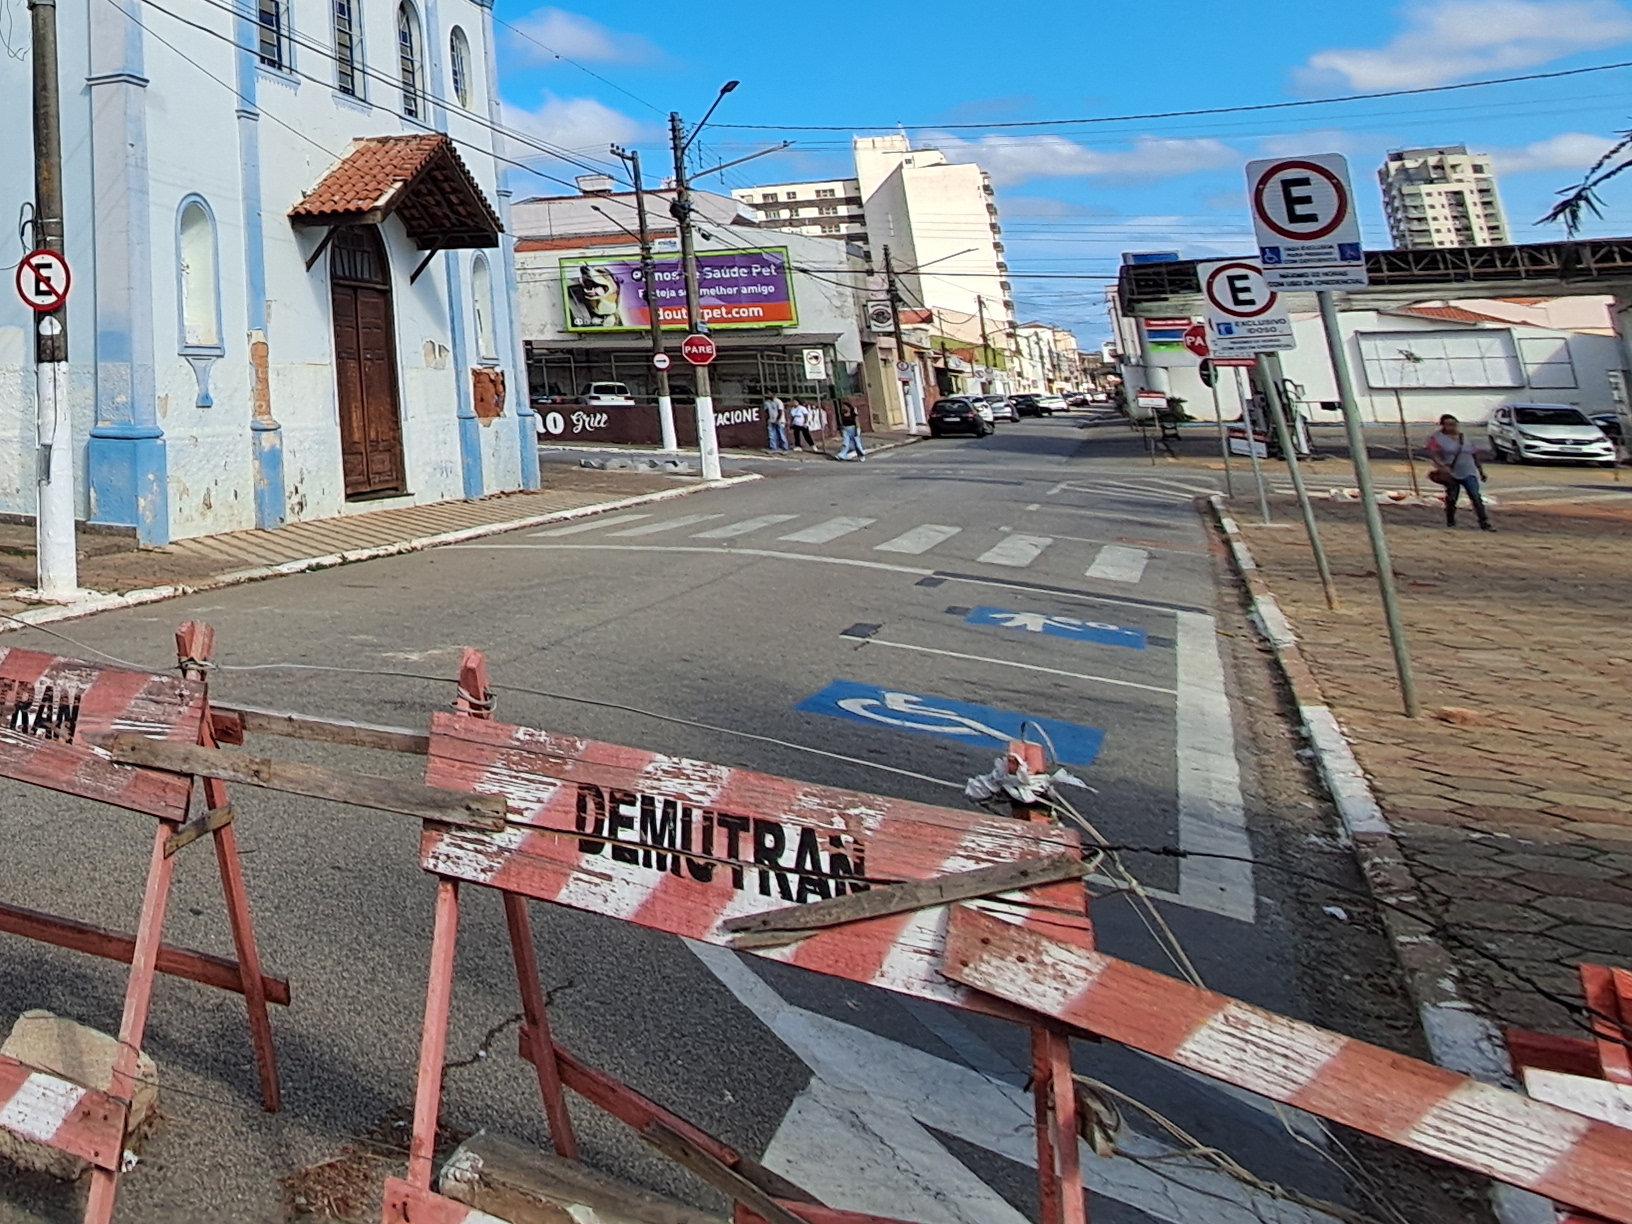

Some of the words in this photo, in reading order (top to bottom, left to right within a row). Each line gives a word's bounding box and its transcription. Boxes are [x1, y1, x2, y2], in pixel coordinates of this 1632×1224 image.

[1279, 176, 1319, 224] E
[34, 263, 53, 296] E
[702, 265, 748, 279] Saúde
[751, 263, 778, 276] Pet
[699, 285, 739, 296] melhor
[740, 283, 775, 295] amigo
[1226, 274, 1256, 306] E
[657, 306, 764, 322] doutpet.com
[684, 344, 713, 355] PARE
[1186, 335, 1207, 347] PA
[570, 410, 608, 434] Grill
[575, 784, 870, 904] DEMUTRAN
